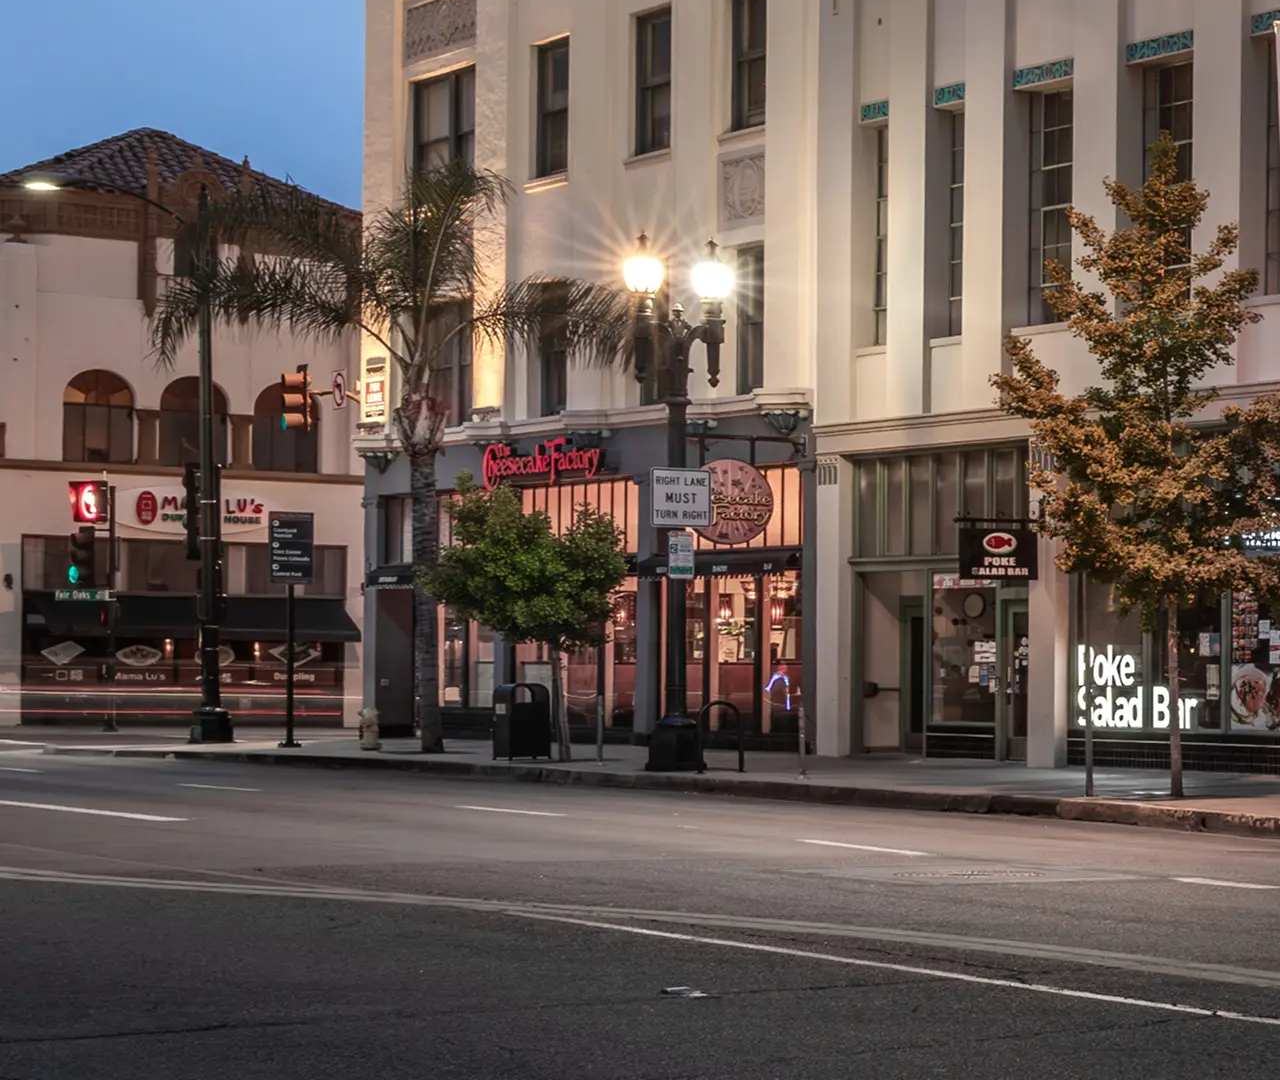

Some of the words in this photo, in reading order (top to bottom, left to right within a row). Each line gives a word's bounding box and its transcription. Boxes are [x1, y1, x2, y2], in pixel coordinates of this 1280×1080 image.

[482, 443, 551, 492] Cheesecake
[544, 437, 600, 485] Factory
[655, 476, 680, 486] RIGHT
[684, 476, 707, 487] LANE
[665, 492, 697, 504] MUST
[655, 509, 678, 519] TURN
[682, 510, 707, 520] RIGHT
[711, 504, 770, 527] Factory
[984, 557, 1016, 566] POKE
[971, 567, 1005, 576] SALAD
[1007, 568, 1029, 576] BAR
[72, 590, 91, 600] Oaks
[1078, 644, 1135, 687] Poke
[274, 672, 315, 681] Dupling
[1077, 686, 1143, 728] Salad
